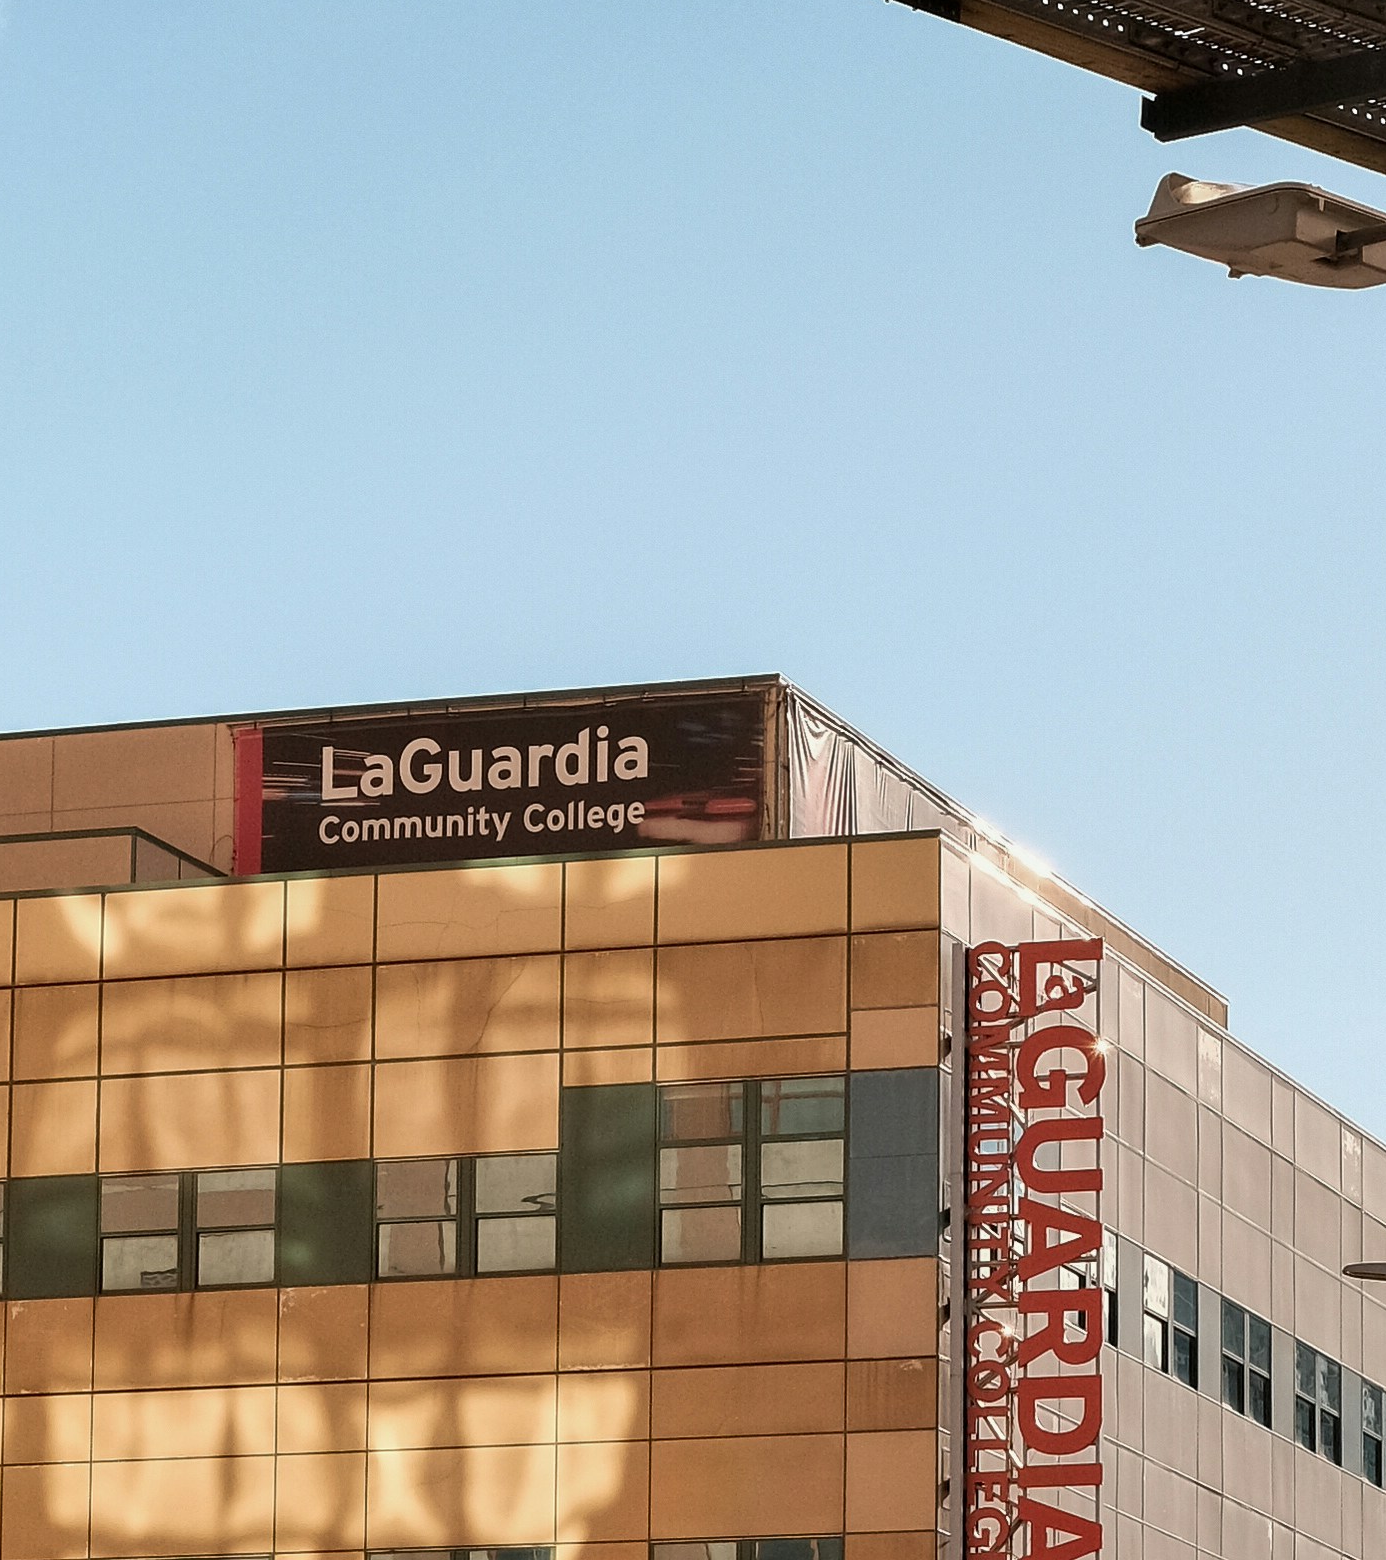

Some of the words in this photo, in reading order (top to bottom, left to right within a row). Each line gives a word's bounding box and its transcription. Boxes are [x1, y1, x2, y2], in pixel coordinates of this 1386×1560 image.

[319, 724, 649, 801] LaGuardia
[319, 805, 511, 845] Community
[523, 800, 646, 835] College
[968, 940, 1012, 1300] COMMUNITY
